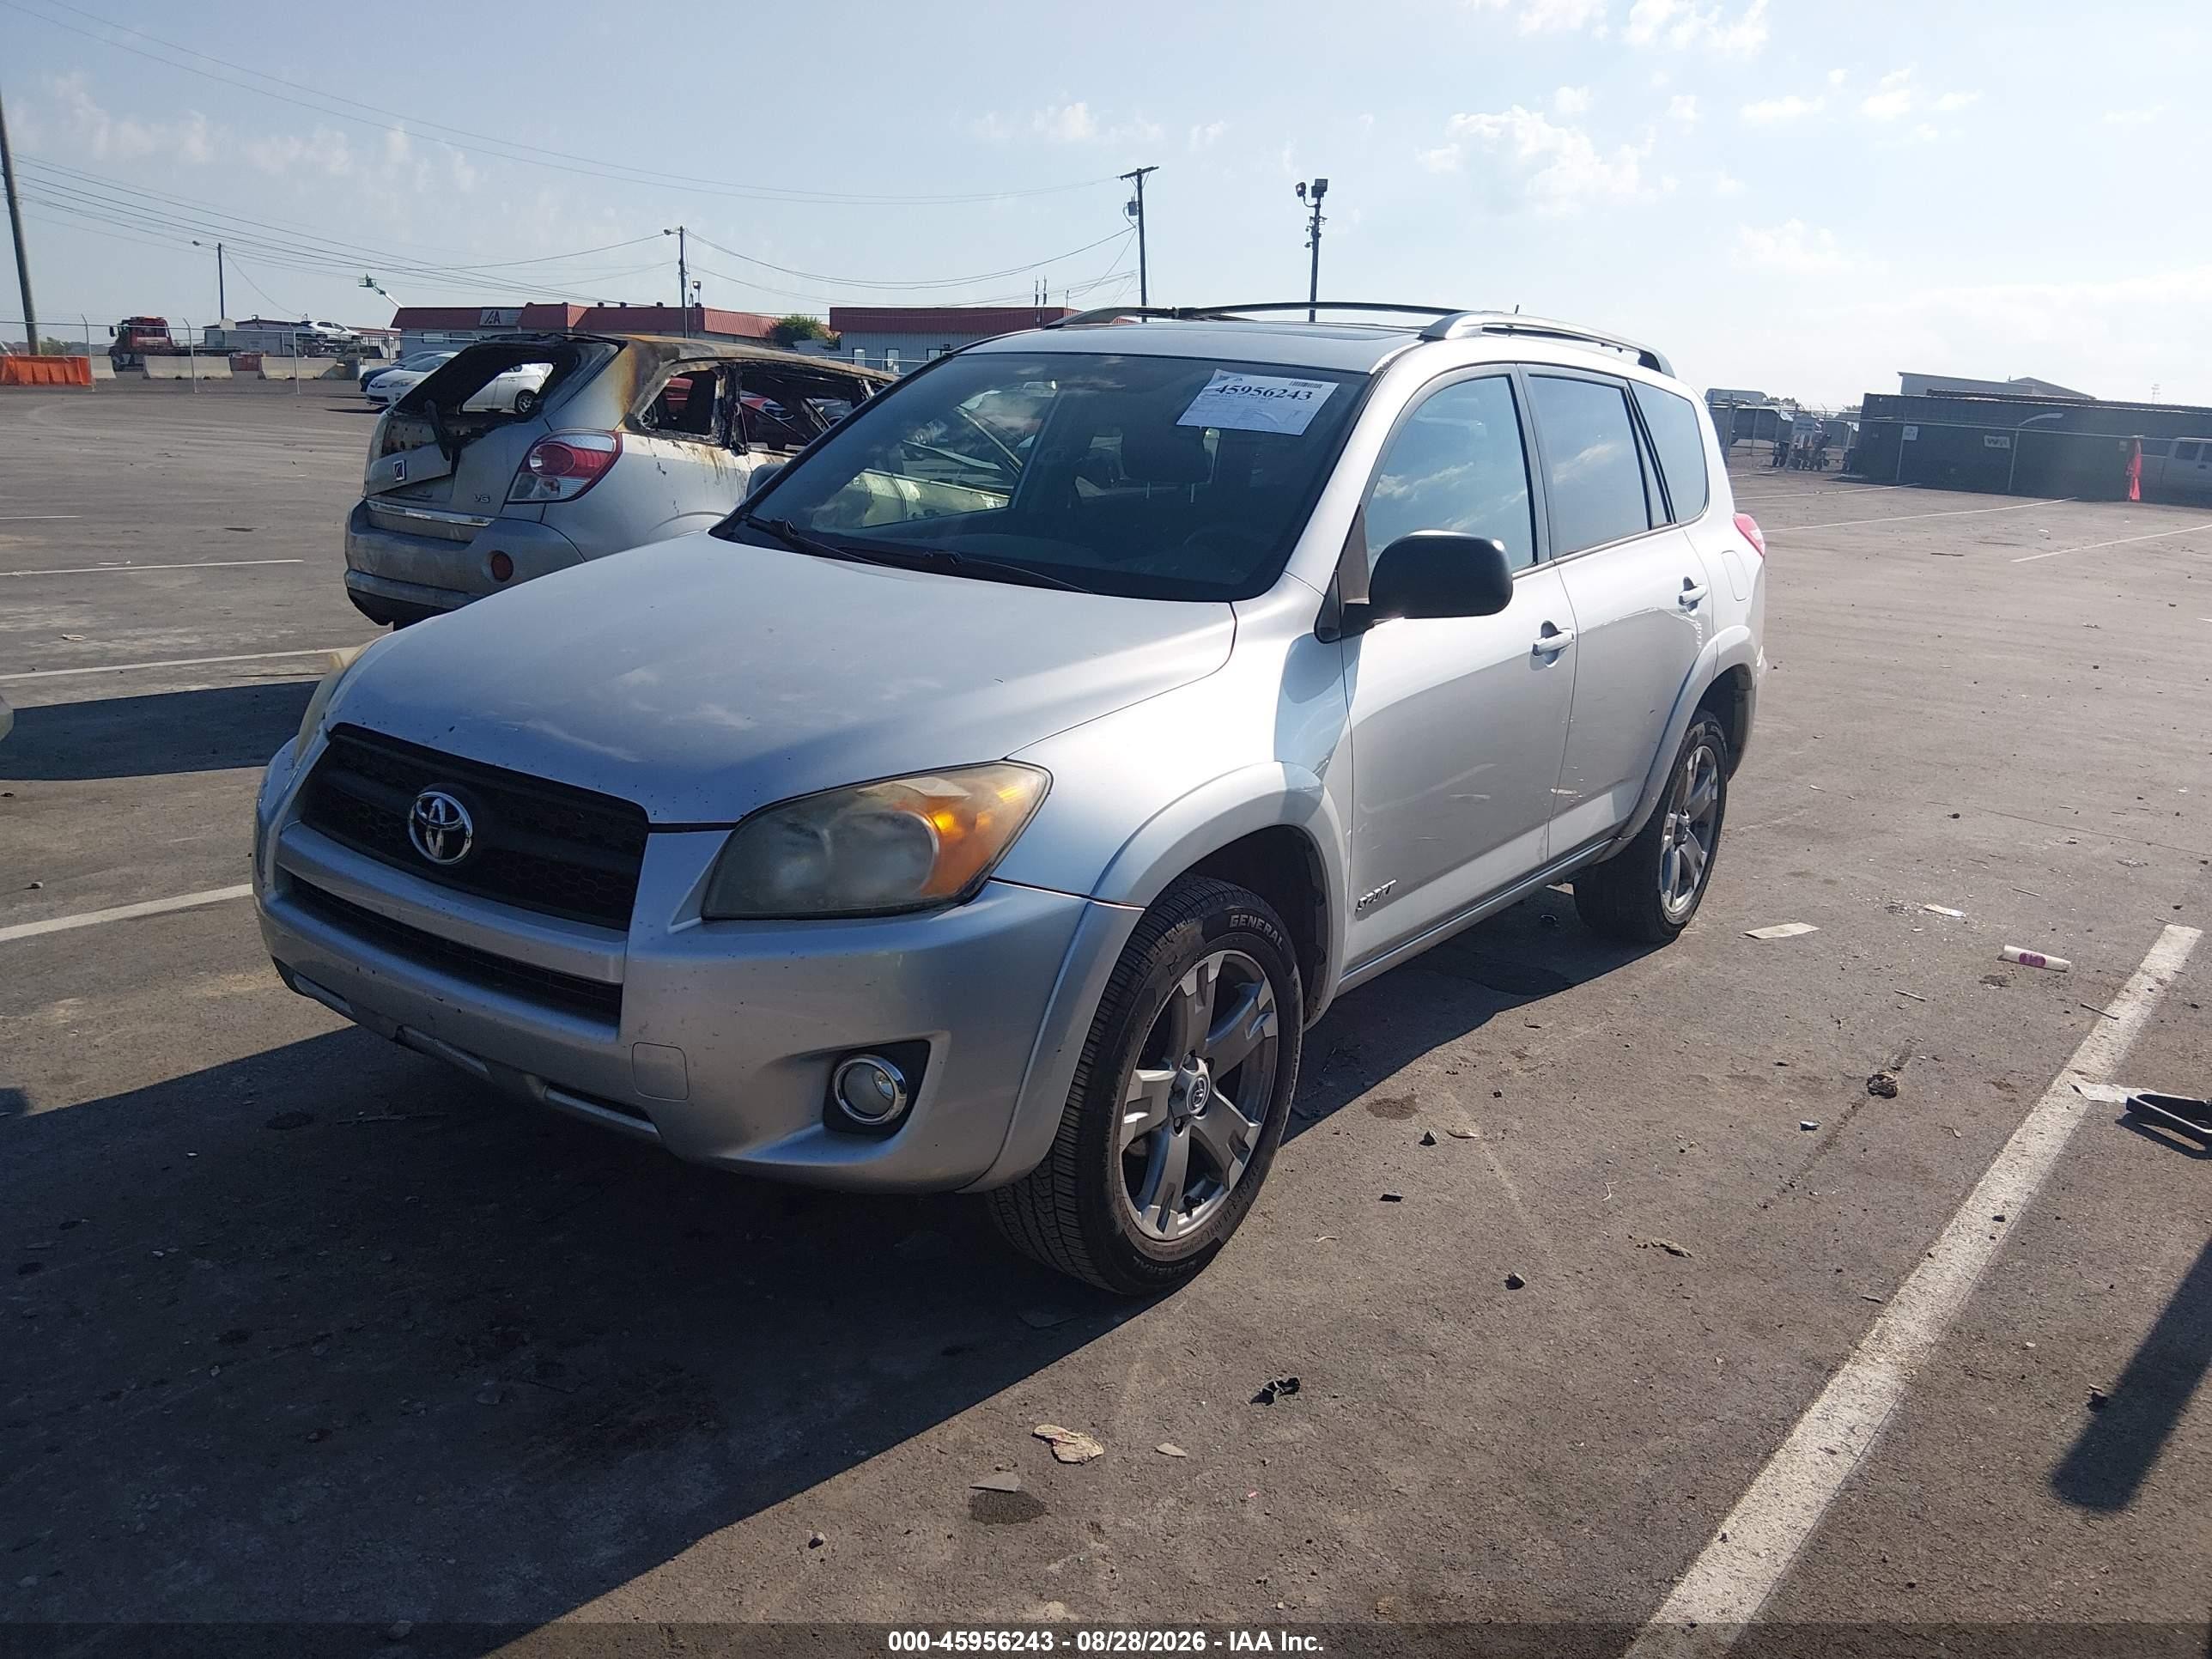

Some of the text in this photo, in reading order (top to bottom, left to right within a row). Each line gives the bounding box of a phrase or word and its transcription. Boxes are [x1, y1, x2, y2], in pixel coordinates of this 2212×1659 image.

[1215, 385, 1313, 401] 45956243
[474, 494, 490, 503] V6
[1229, 914, 1284, 950] GENERAL
